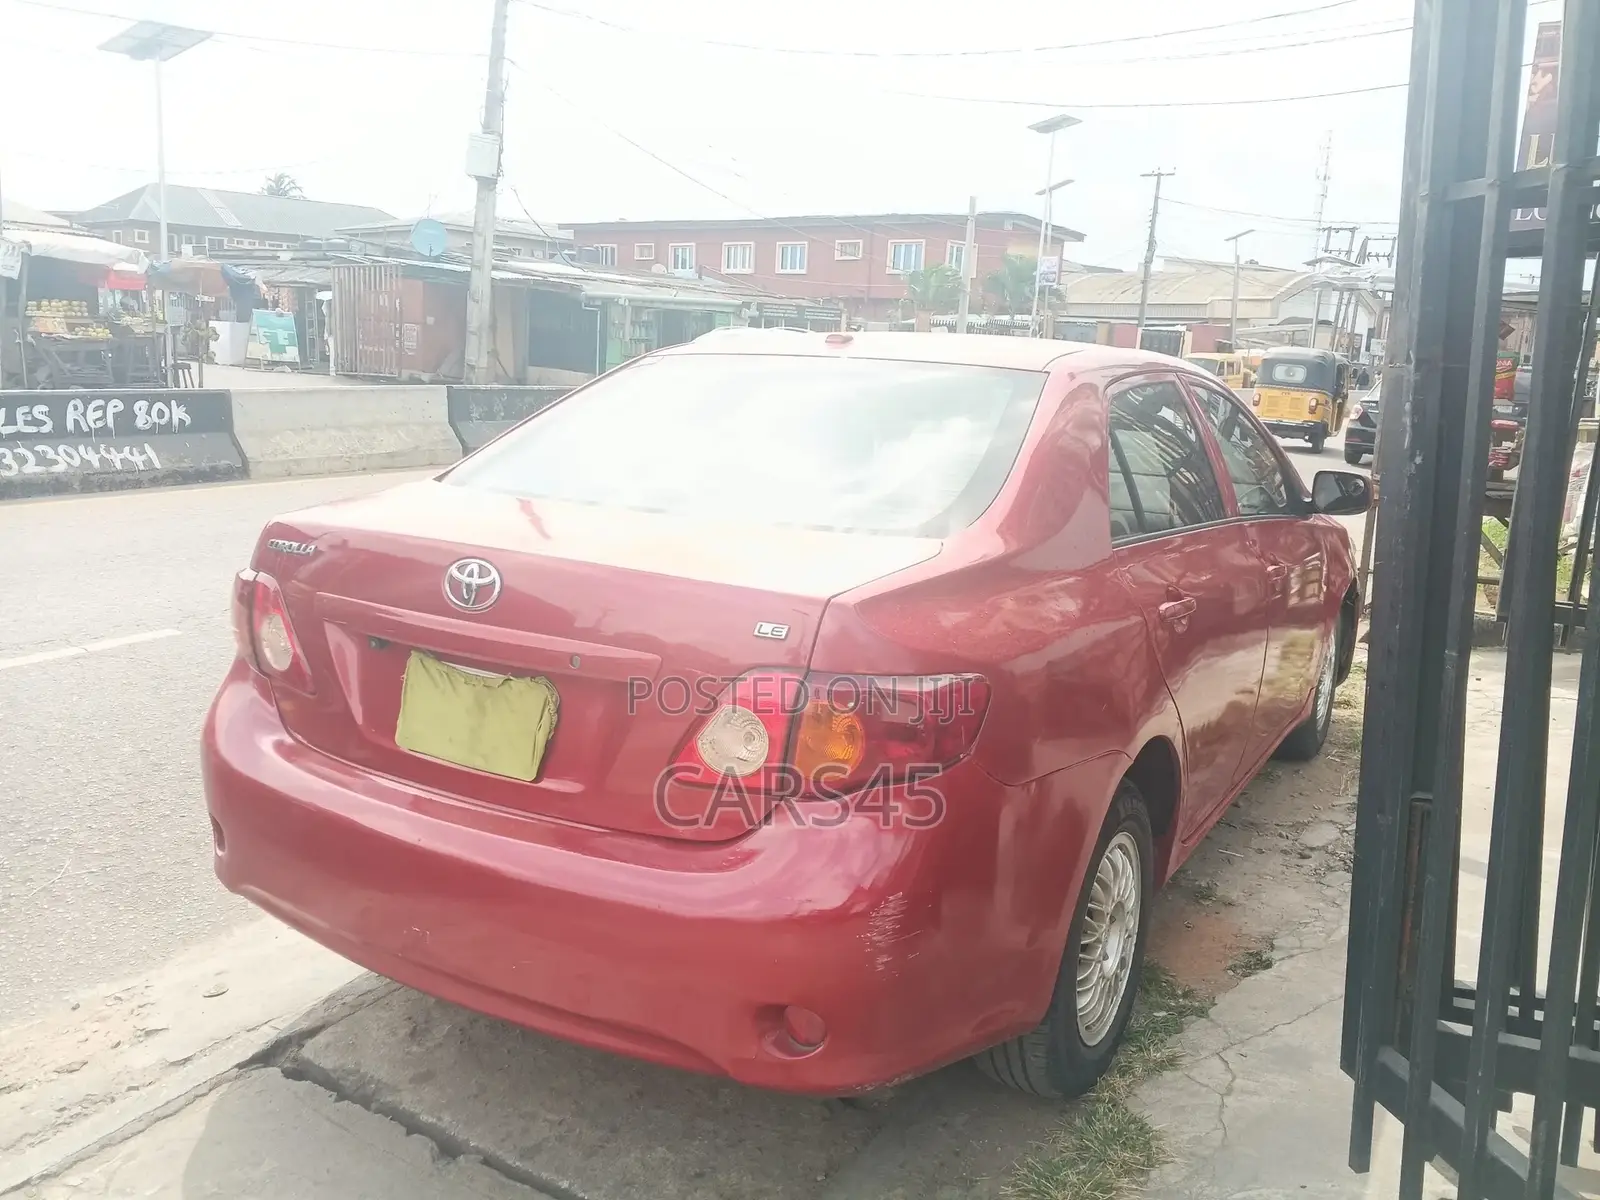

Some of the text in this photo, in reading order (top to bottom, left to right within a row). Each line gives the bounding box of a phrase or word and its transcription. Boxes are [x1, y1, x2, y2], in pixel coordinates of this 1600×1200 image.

[66, 398, 124, 438] REP
[133, 399, 191, 434] 80K
[757, 623, 786, 637] LE
